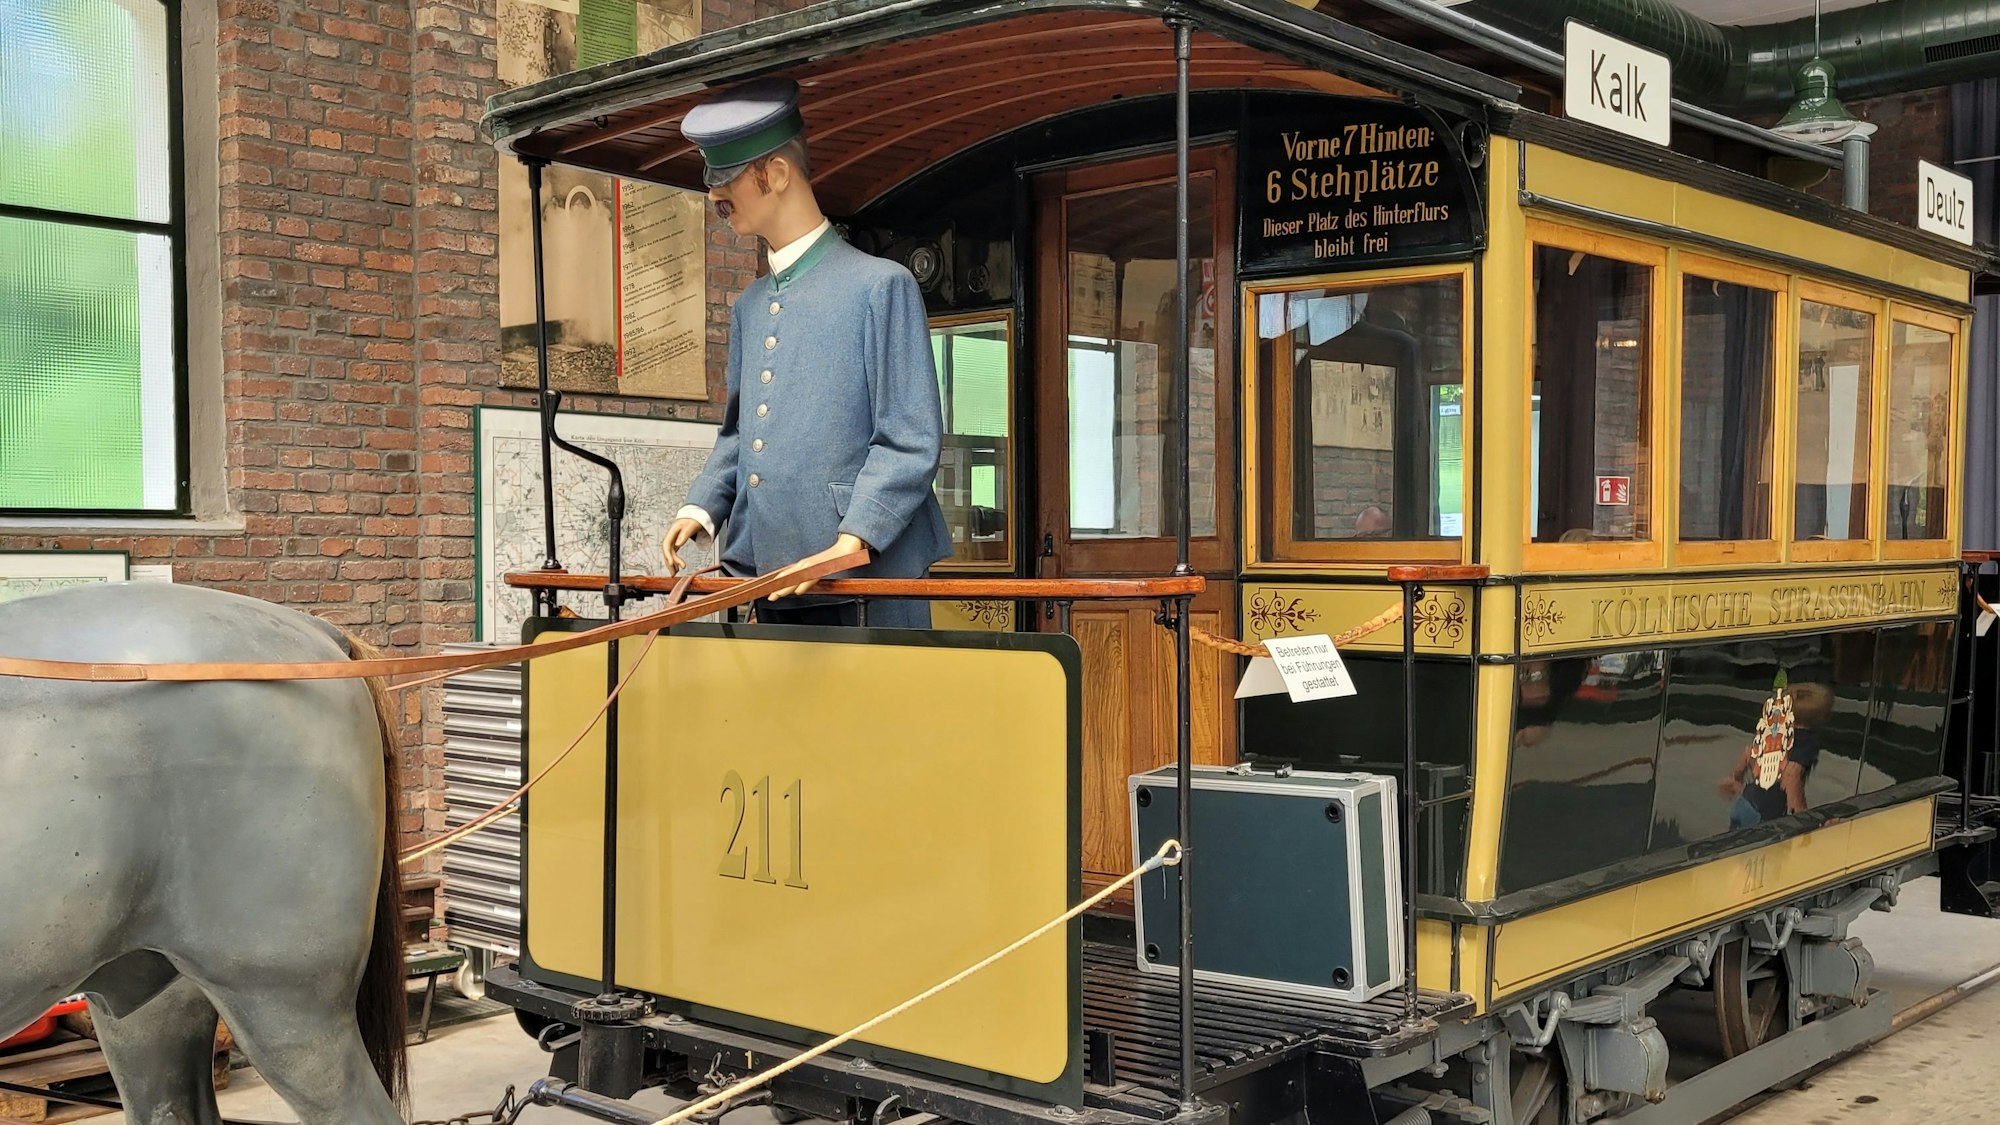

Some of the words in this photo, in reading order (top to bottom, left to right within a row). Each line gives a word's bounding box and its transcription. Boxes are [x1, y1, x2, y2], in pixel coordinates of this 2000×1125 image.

[1591, 49, 1647, 122] Kalk
[1281, 131, 1341, 162] Vorne
[1344, 125, 1357, 156] 7
[1359, 123, 1435, 155] Hinten:
[1267, 170, 1282, 204] 6
[1291, 159, 1439, 202] Stehplätze
[1263, 218, 1303, 238] Dieser
[1307, 212, 1339, 233] Platz
[1345, 209, 1367, 229] des
[1373, 202, 1449, 226] Hinterflurs
[1927, 176, 1965, 230] Deutz
[1314, 236, 1355, 259] bleibt
[1363, 232, 1388, 254] frei
[1591, 588, 1752, 638] KÖLNISCHE
[1769, 579, 1927, 626] STRASSENBAHN
[1275, 646, 1313, 658] Betreten
[1314, 644, 1328, 654] nur
[1281, 662, 1296, 675] bei
[1296, 659, 1342, 673] Führungen
[1302, 676, 1339, 693] gestattet
[716, 769, 808, 890] 211
[1742, 854, 1766, 894] 211
[744, 1050, 752, 1070] 1
